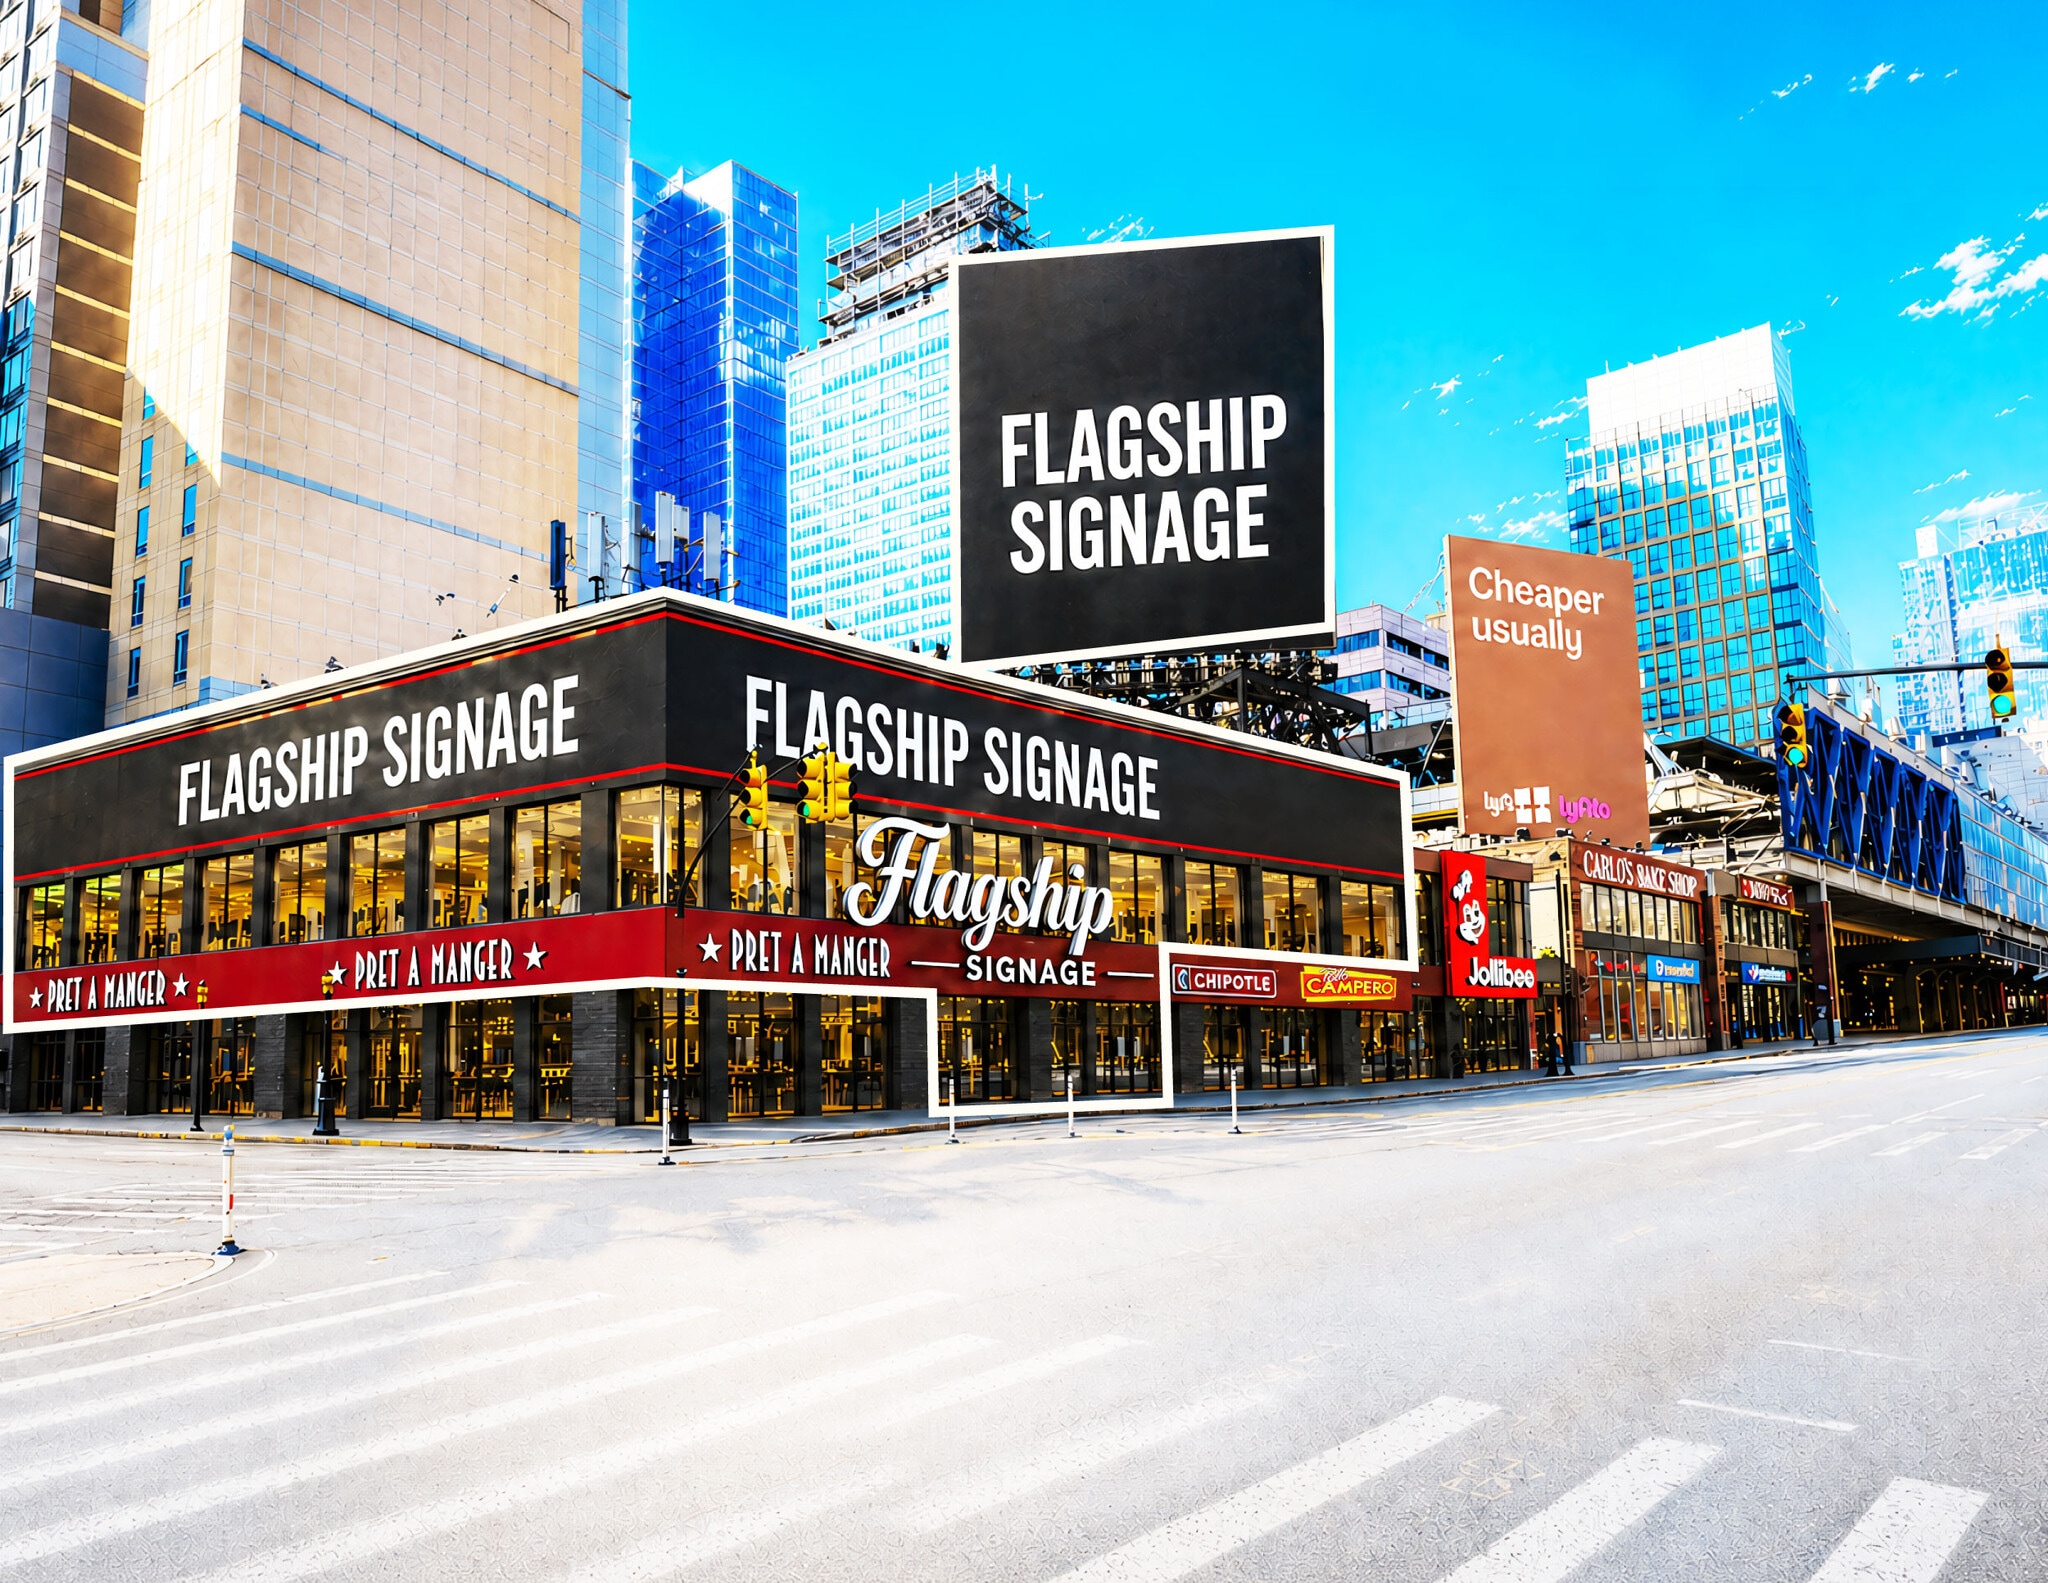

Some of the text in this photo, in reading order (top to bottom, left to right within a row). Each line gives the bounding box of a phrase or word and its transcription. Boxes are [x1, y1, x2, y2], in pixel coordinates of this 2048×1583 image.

[1001, 393, 1287, 488] FLAGSHIP
[1009, 483, 1270, 574] SIGNAGE
[1468, 566, 1605, 618] Cheaper
[1471, 616, 1582, 661] usually
[177, 674, 580, 827] FLAGSHIP SIGNAGE
[746, 674, 1161, 820] FLAGSHIP SIGNAGE
[842, 816, 1114, 956] Flagship
[1583, 850, 1634, 886] CARLO'S
[355, 938, 513, 990] PRET A MANGER
[731, 928, 891, 978] PRET A MANGER
[966, 954, 1097, 987] SIGNAGE
[1468, 956, 1535, 989] Jollibee
[47, 969, 166, 1013] PRET A MANGER
[1194, 972, 1271, 992] CHIPOTLE
[1306, 977, 1394, 995] CAMPERO
